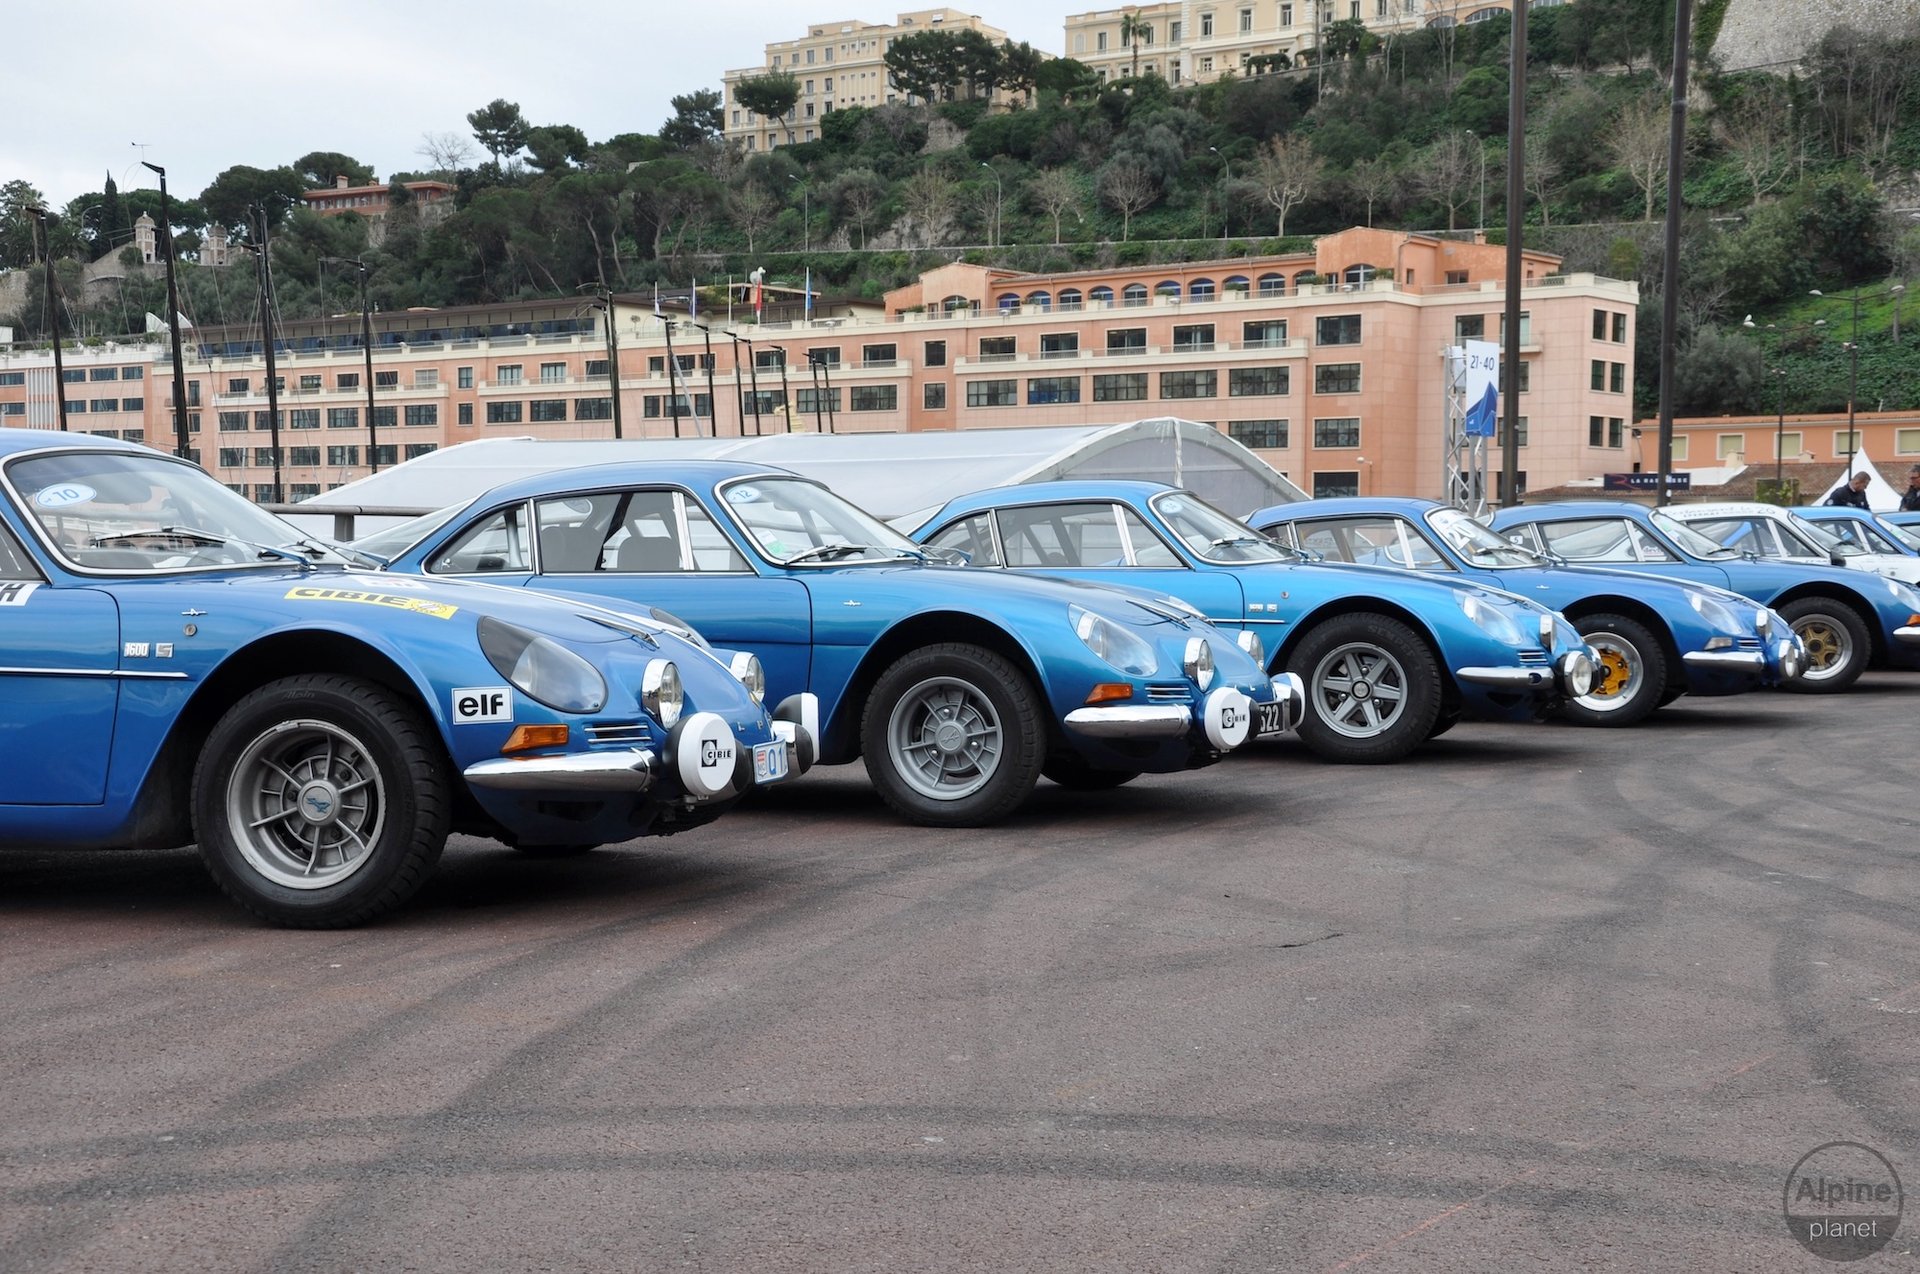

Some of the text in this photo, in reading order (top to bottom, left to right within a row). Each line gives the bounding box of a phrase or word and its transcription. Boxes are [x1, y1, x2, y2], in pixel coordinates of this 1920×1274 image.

[52, 488, 79, 501] 10
[295, 588, 411, 606] CIBIE
[125, 643, 149, 657] 1600
[458, 693, 503, 717] elf
